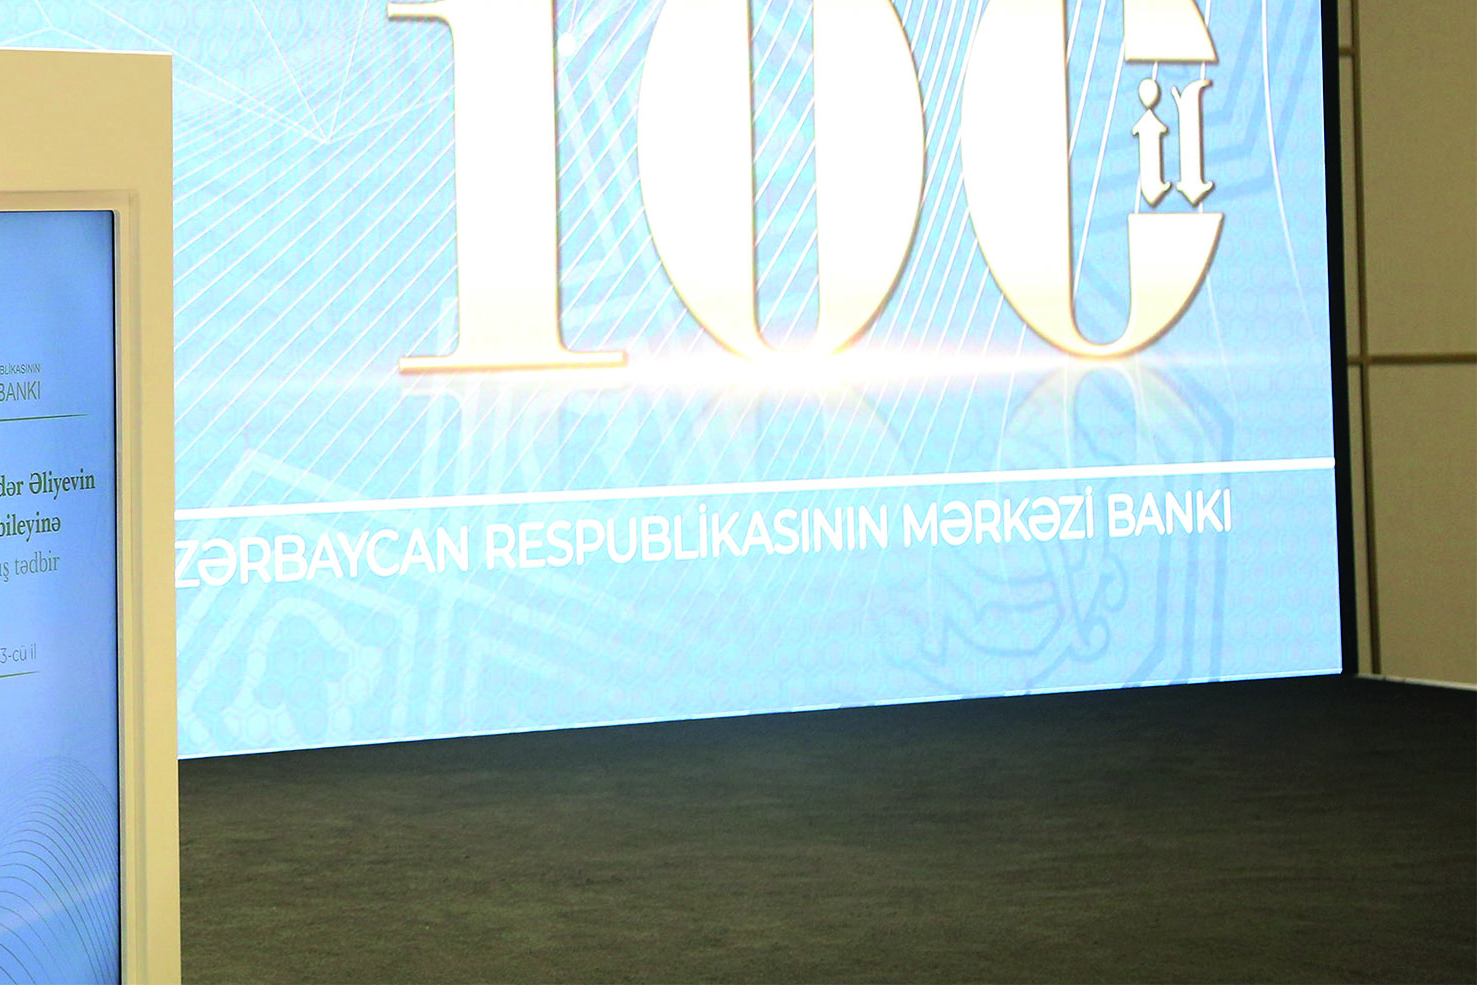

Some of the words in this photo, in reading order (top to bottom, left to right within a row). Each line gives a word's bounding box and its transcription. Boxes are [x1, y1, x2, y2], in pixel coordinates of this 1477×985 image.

[28, 468, 96, 500] Əliyevin
[174, 526, 469, 589] ZƏRBAYCAN
[484, 503, 889, 571] RESPUBLİKASININ
[901, 485, 1094, 547] MƏRKƏZİ
[1107, 488, 1232, 538] BANKI
[14, 550, 61, 576] tədbir
[30, 643, 38, 660] il
